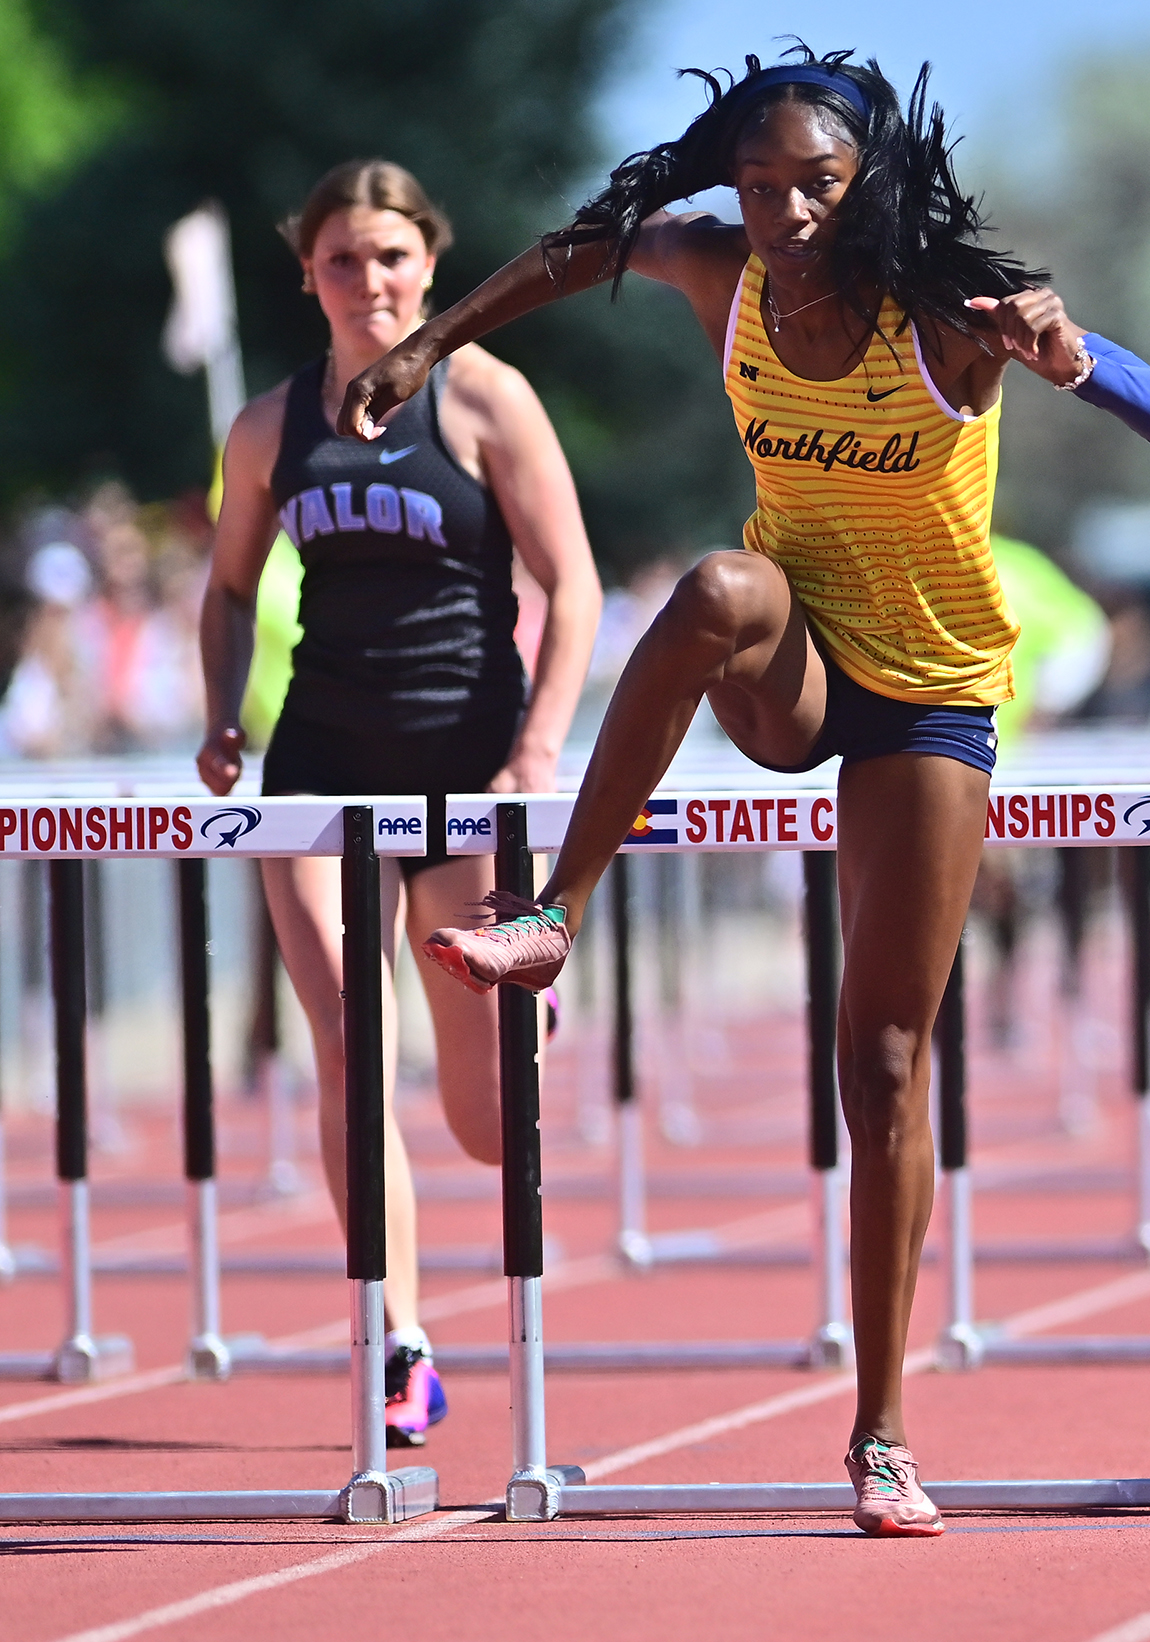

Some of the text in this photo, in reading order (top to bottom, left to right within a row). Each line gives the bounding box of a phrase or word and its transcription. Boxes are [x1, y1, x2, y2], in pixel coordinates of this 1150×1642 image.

[739, 361, 759, 382] N
[744, 417, 920, 473] Northfield
[279, 482, 448, 548] VALOR
[685, 799, 798, 844] STATE
